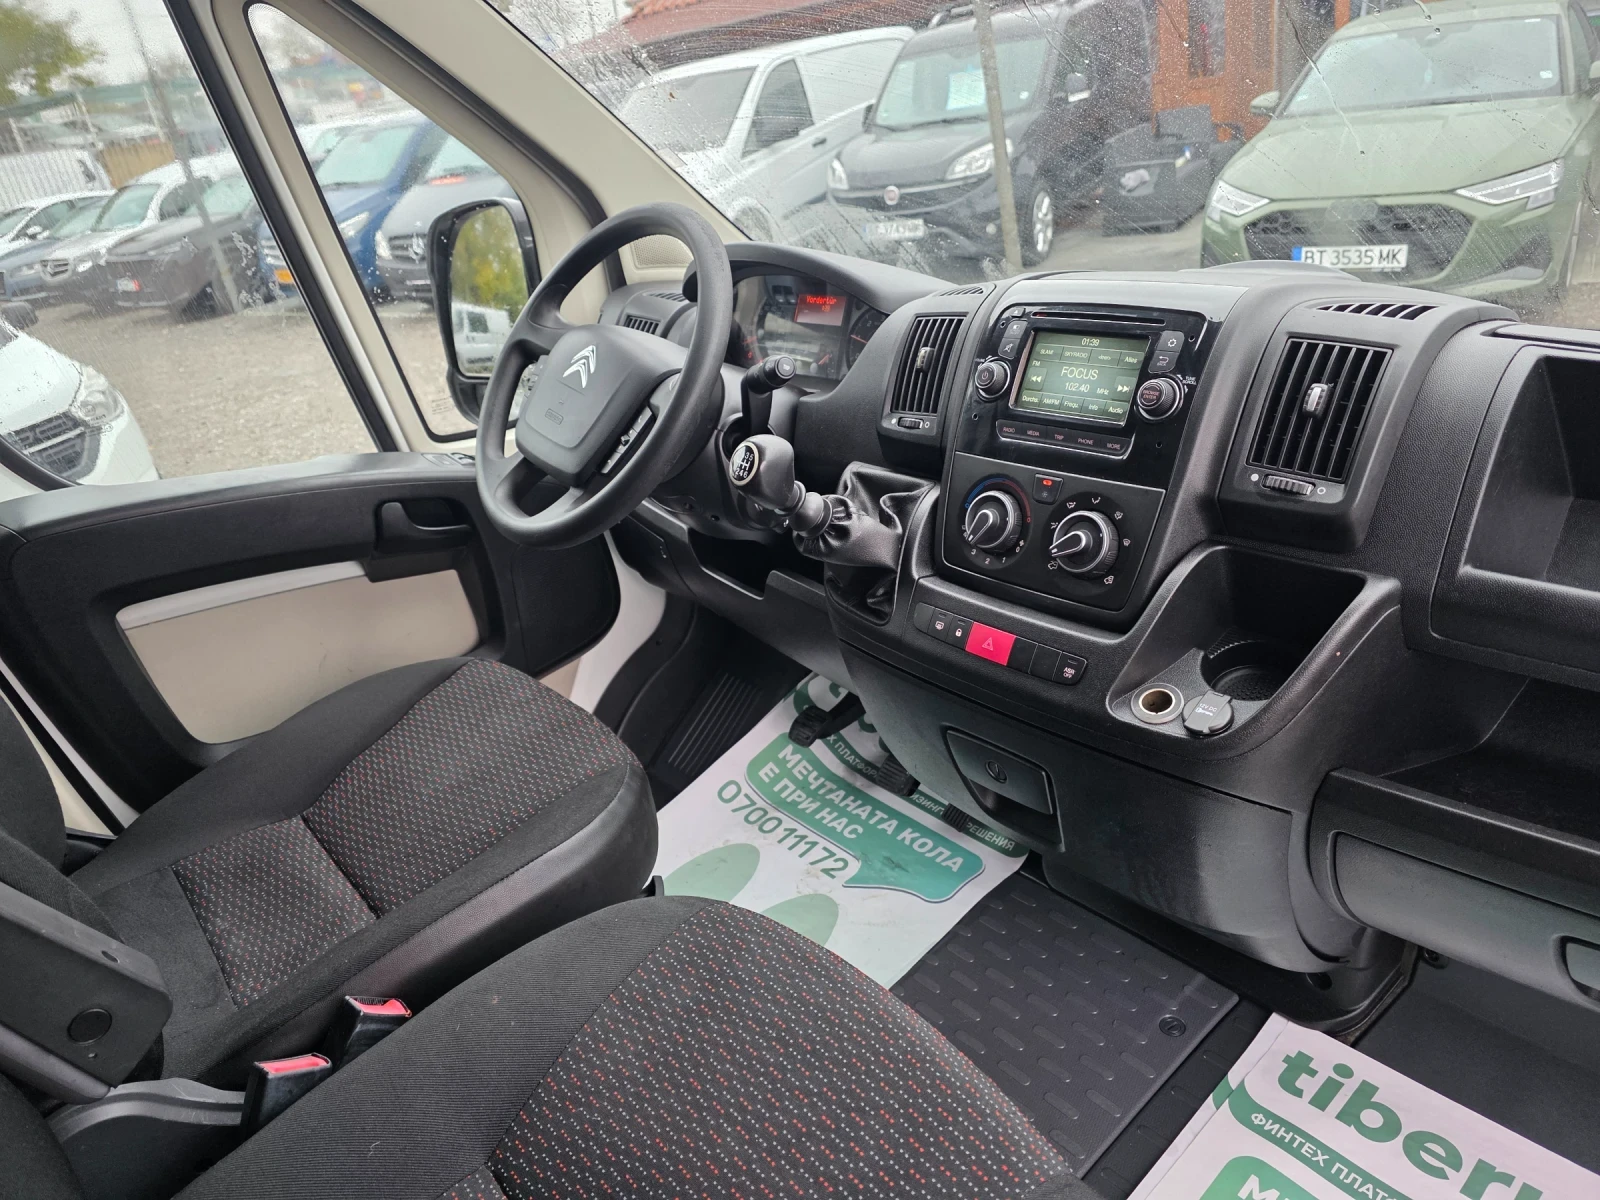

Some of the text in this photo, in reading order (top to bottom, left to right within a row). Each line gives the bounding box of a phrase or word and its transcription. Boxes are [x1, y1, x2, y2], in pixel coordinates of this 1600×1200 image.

[1330, 249, 1374, 266] 3535
[1378, 248, 1402, 265] MK
[1081, 337, 1100, 347] 01:39
[1060, 366, 1098, 380] FOCUS
[1065, 382, 1110, 396] 102.40 MHz
[1108, 406, 1124, 415] Audio
[1026, 429, 1040, 437] MEDIA
[1078, 437, 1094, 446] PHONE
[1107, 442, 1121, 450] MORE
[984, 557, 990, 565] 2
[835, 741, 878, 778] ПЛАТФОР
[758, 762, 864, 839] Е ПРИ НАС
[778, 744, 964, 872] МЕЧТАНАТА КОЛА
[909, 792, 944, 815] ИЗИНГ
[1251, 1113, 1398, 1200] ФИНТЕХ ПЛАТ
